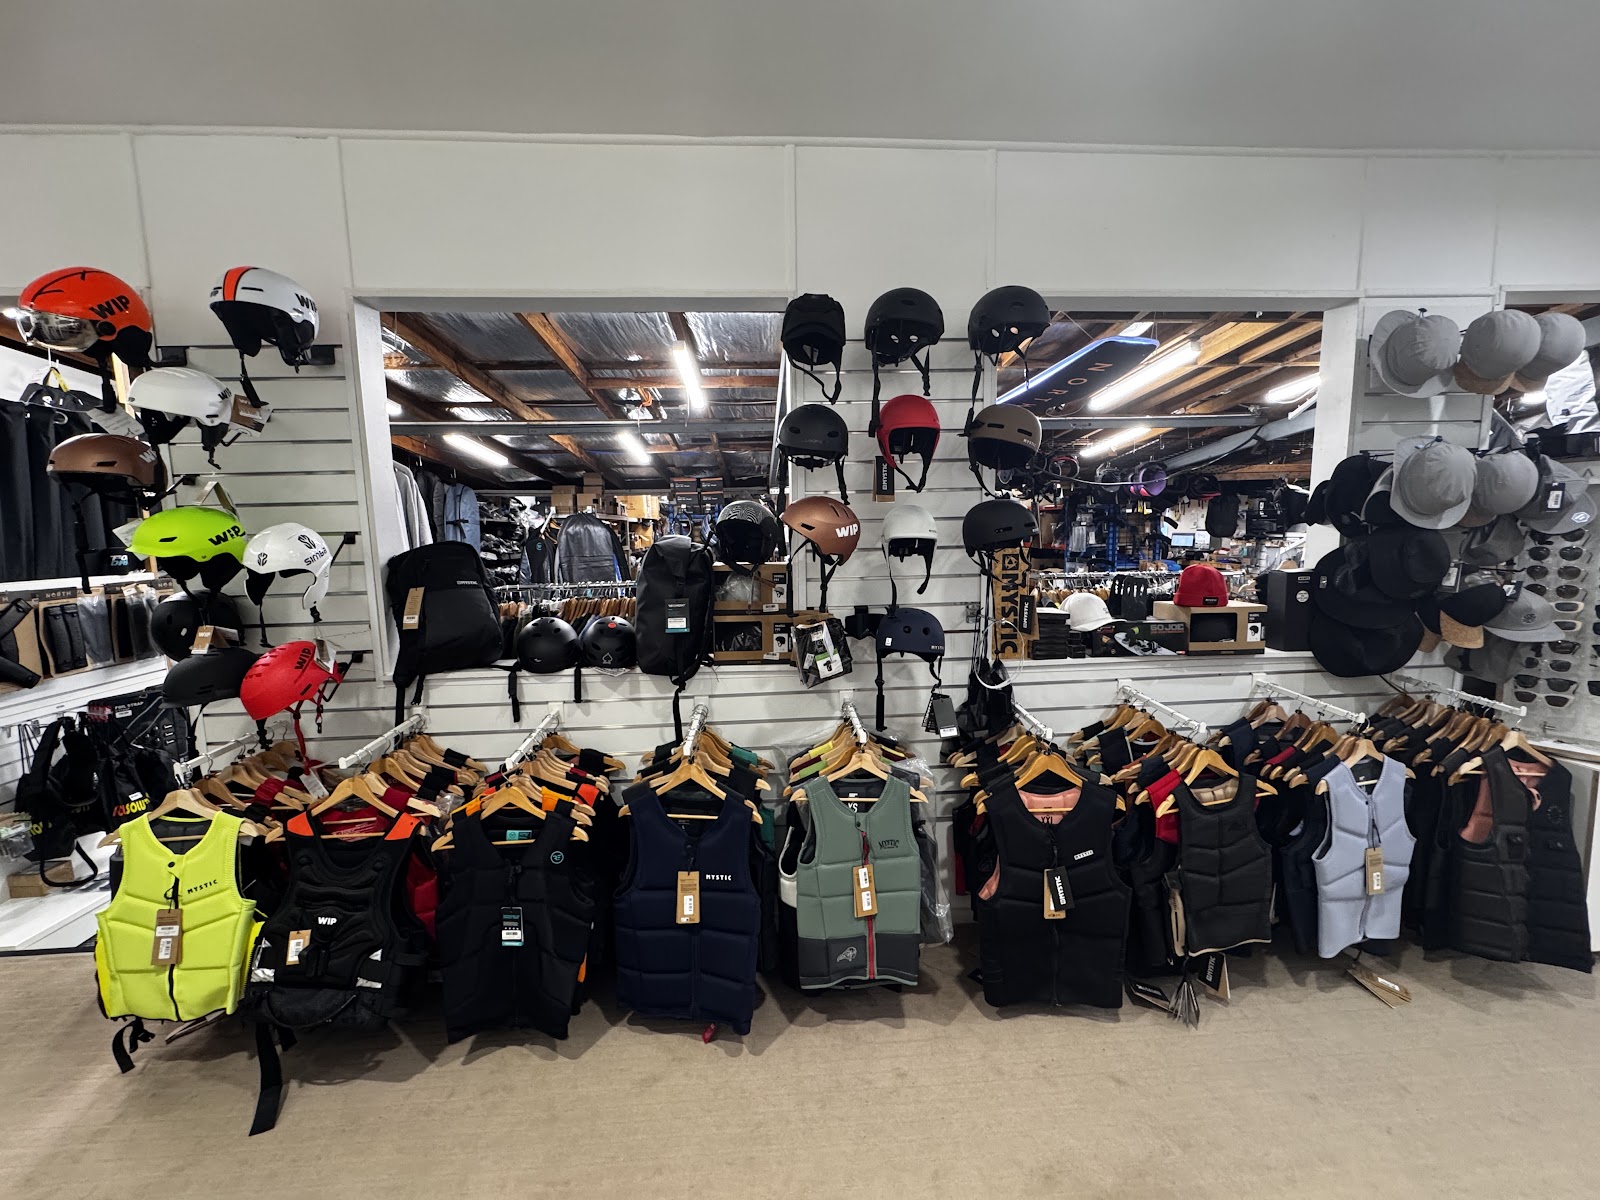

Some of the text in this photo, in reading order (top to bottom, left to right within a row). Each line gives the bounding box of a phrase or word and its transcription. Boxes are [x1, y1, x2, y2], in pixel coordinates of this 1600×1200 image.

[88, 295, 130, 319] WIP
[835, 523, 859, 538] WIP
[45, 590, 72, 599] NORTH
[1001, 573, 1019, 653] MYSTIC
[294, 647, 312, 670] WIP
[878, 839, 900, 850] MYSTIC
[705, 873, 732, 881] MYSTIC
[187, 879, 218, 895] MYSTIC
[1055, 875, 1066, 901] MYSTIC
[318, 916, 337, 926] WIP
